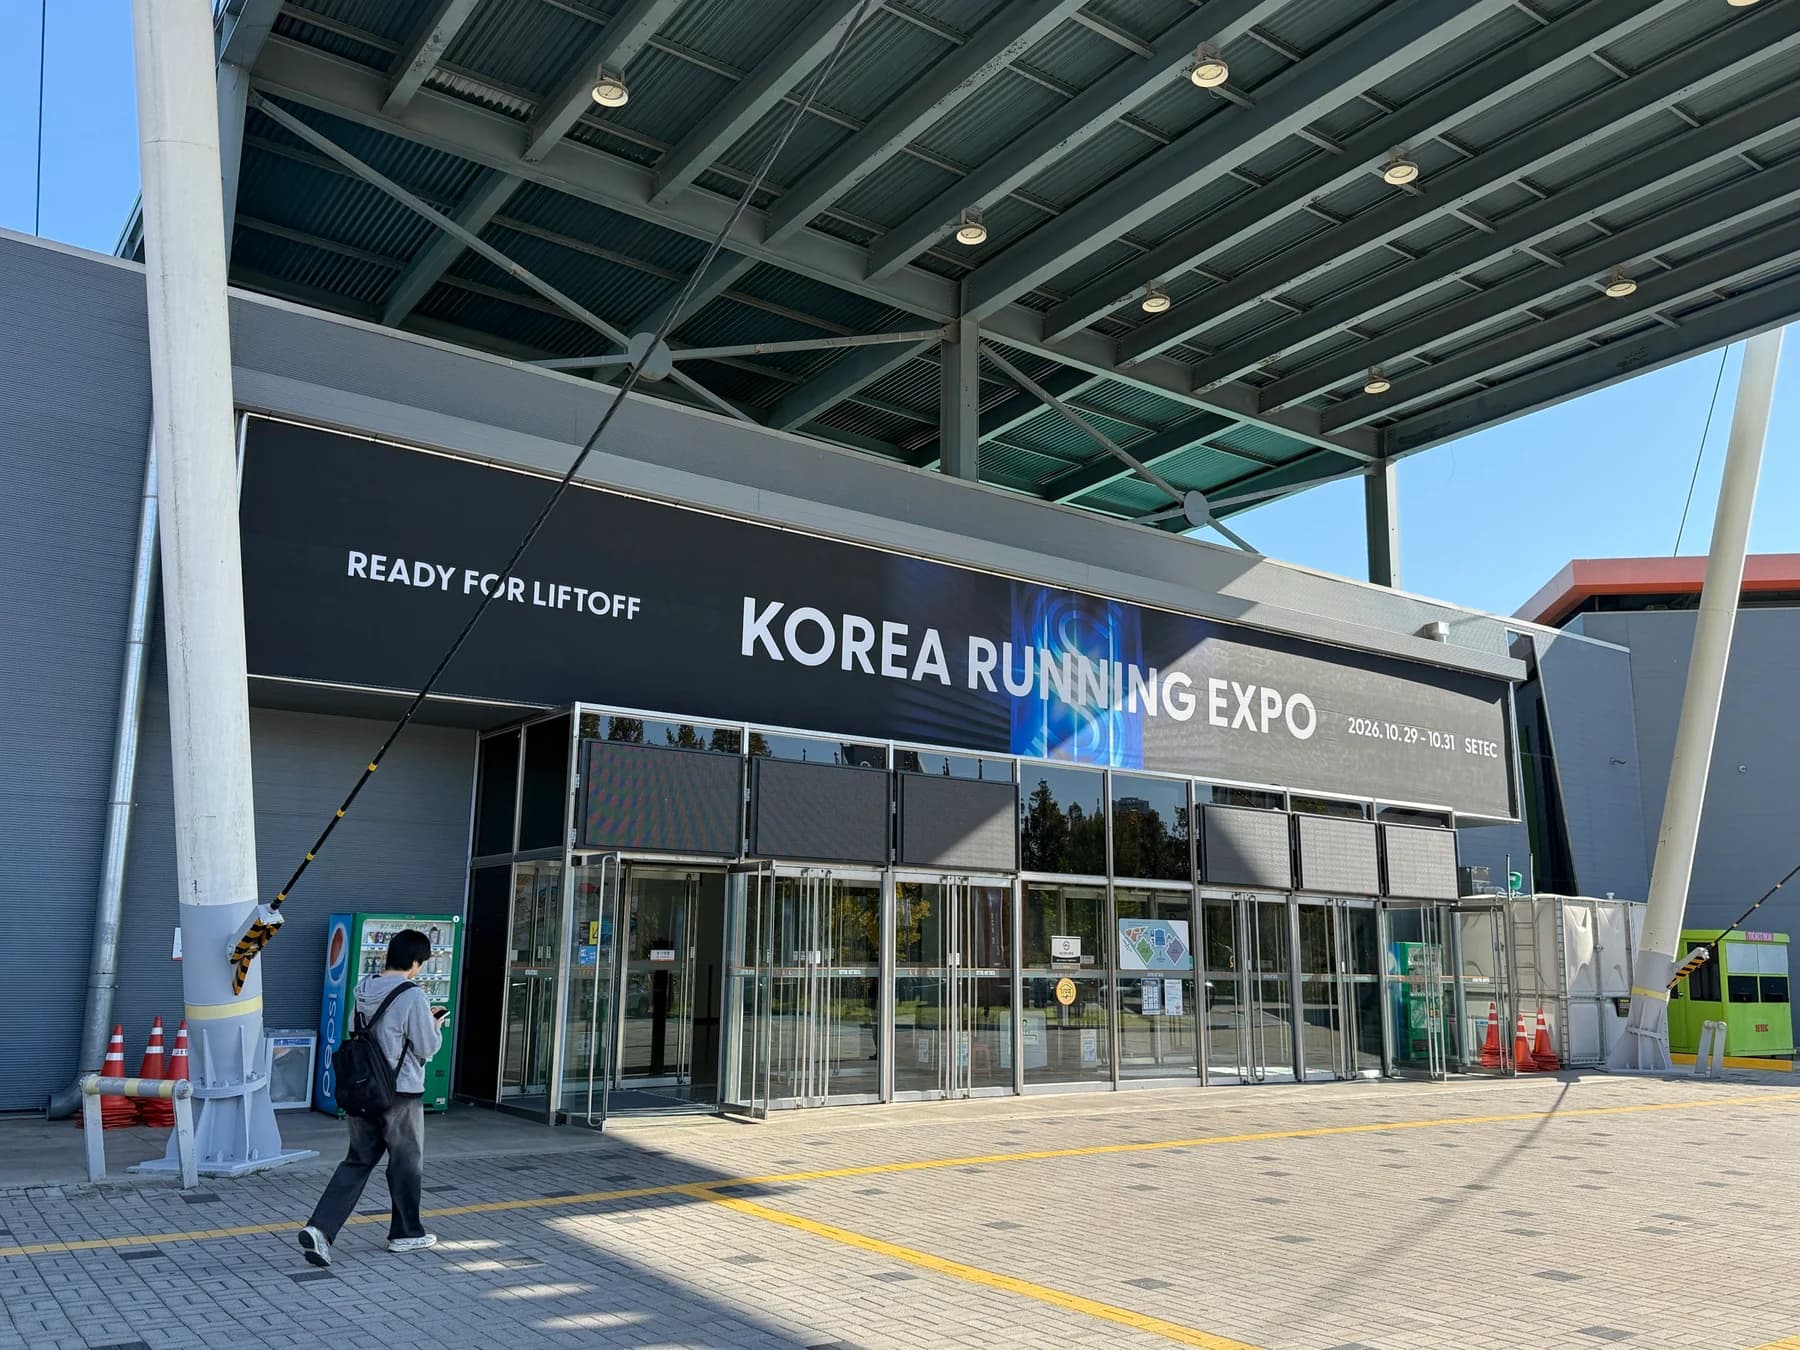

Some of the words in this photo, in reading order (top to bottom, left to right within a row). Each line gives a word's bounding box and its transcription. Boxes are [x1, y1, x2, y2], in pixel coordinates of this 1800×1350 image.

[347, 550, 456, 591] READY
[463, 570, 525, 603] FOR
[533, 581, 641, 620] LIFTOFF
[741, 596, 952, 686] KOREA
[967, 635, 1197, 722] RUNNING
[1208, 677, 1317, 741] EXPO
[1465, 737, 1498, 759] SETEC
[322, 992, 338, 1098] pepsi
